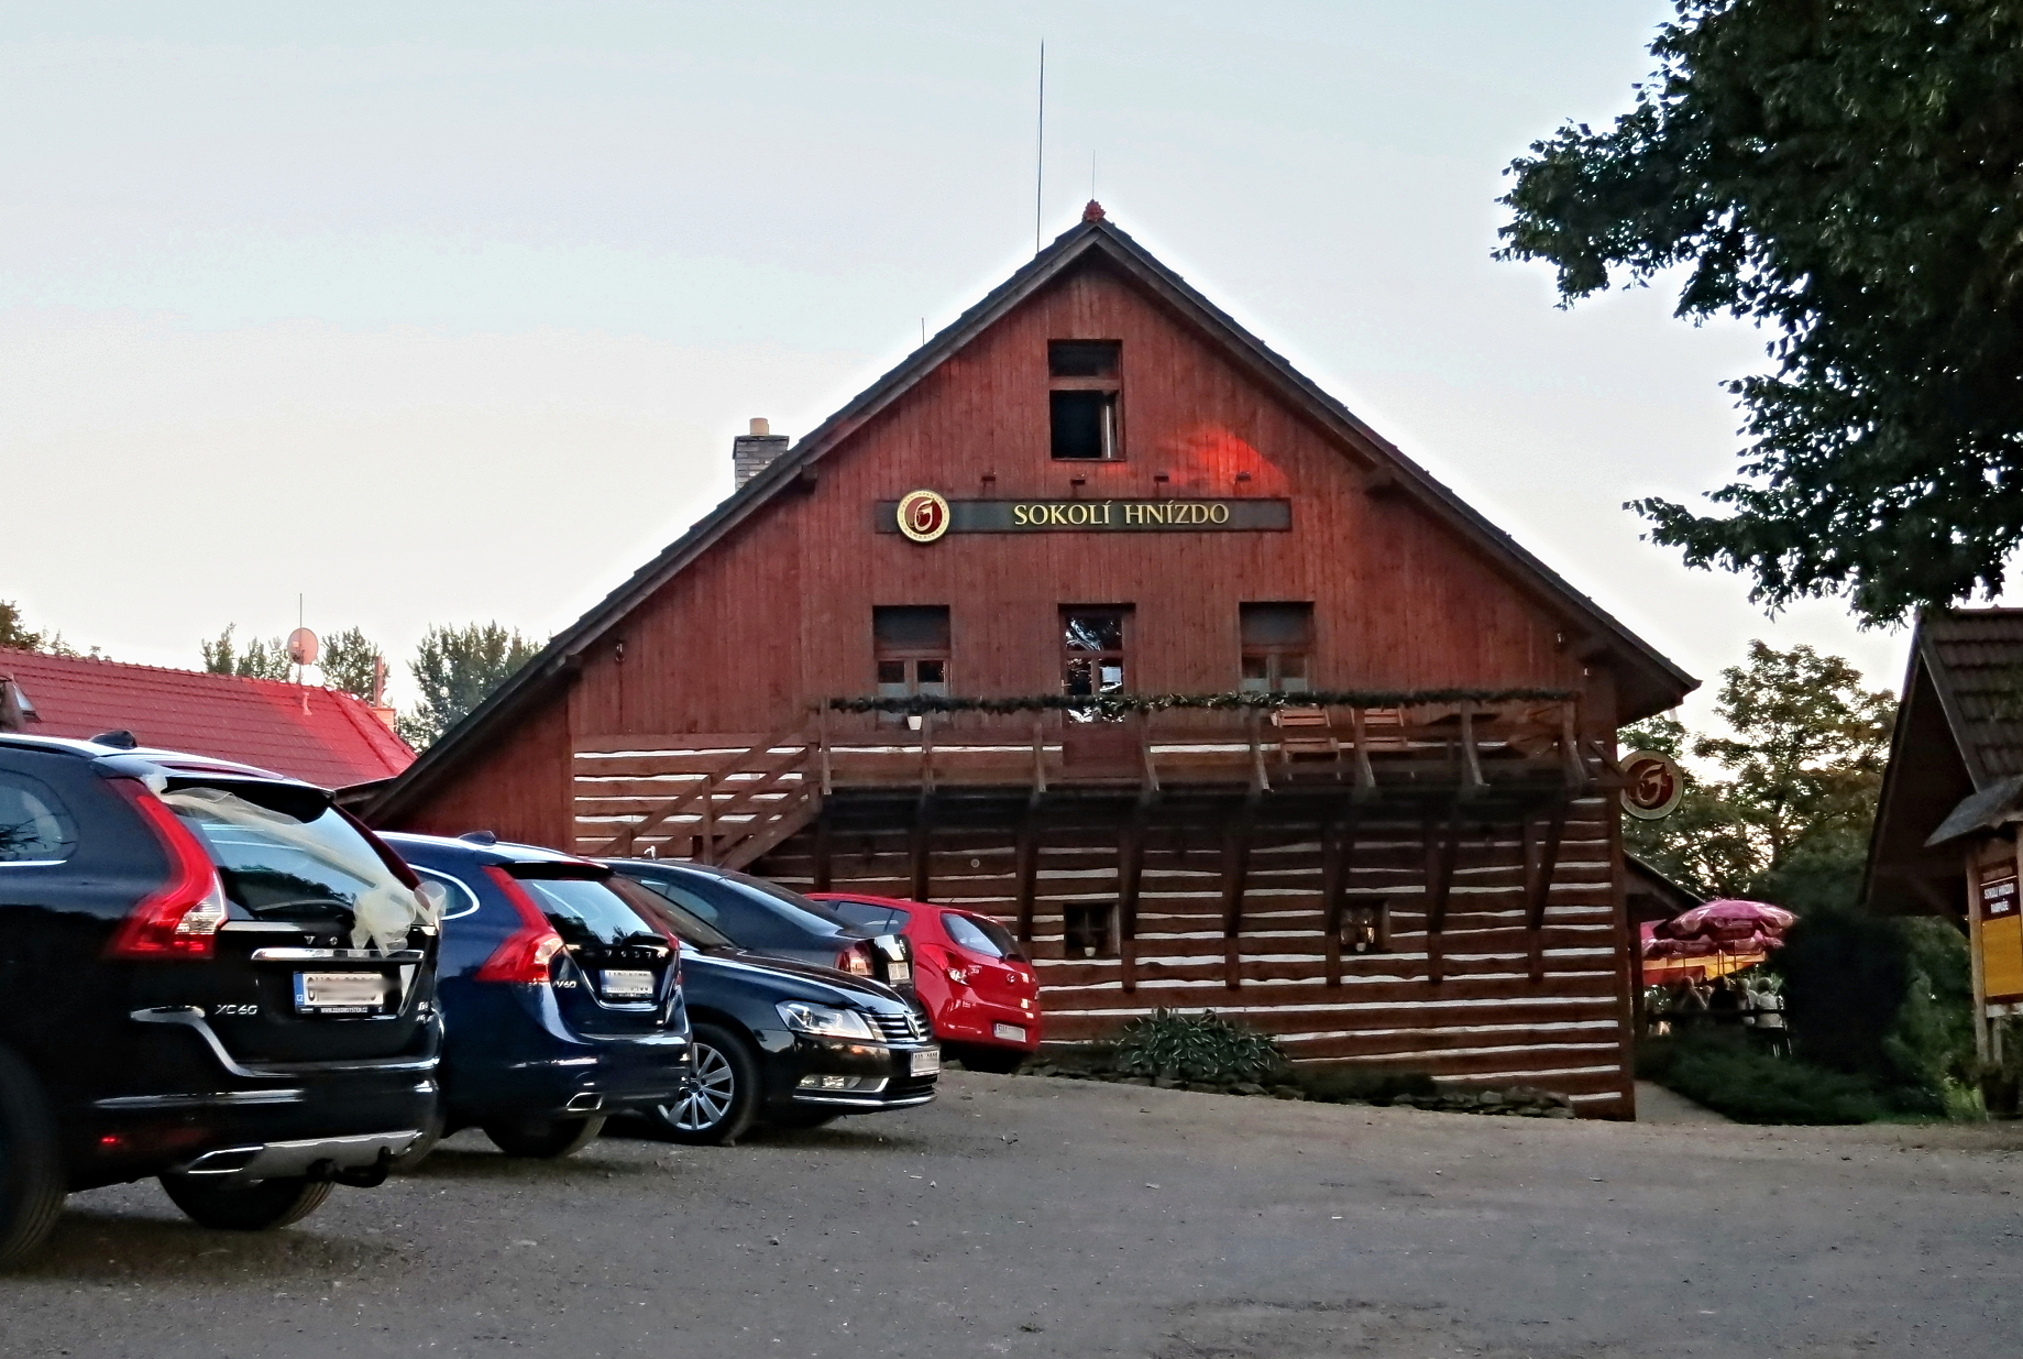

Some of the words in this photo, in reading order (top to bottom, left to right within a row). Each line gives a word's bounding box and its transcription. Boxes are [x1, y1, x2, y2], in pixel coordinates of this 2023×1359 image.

[1013, 500, 1113, 525] SOKOLÍ
[1123, 500, 1230, 525] HNÍZDO
[214, 1004, 259, 1015] XC60
